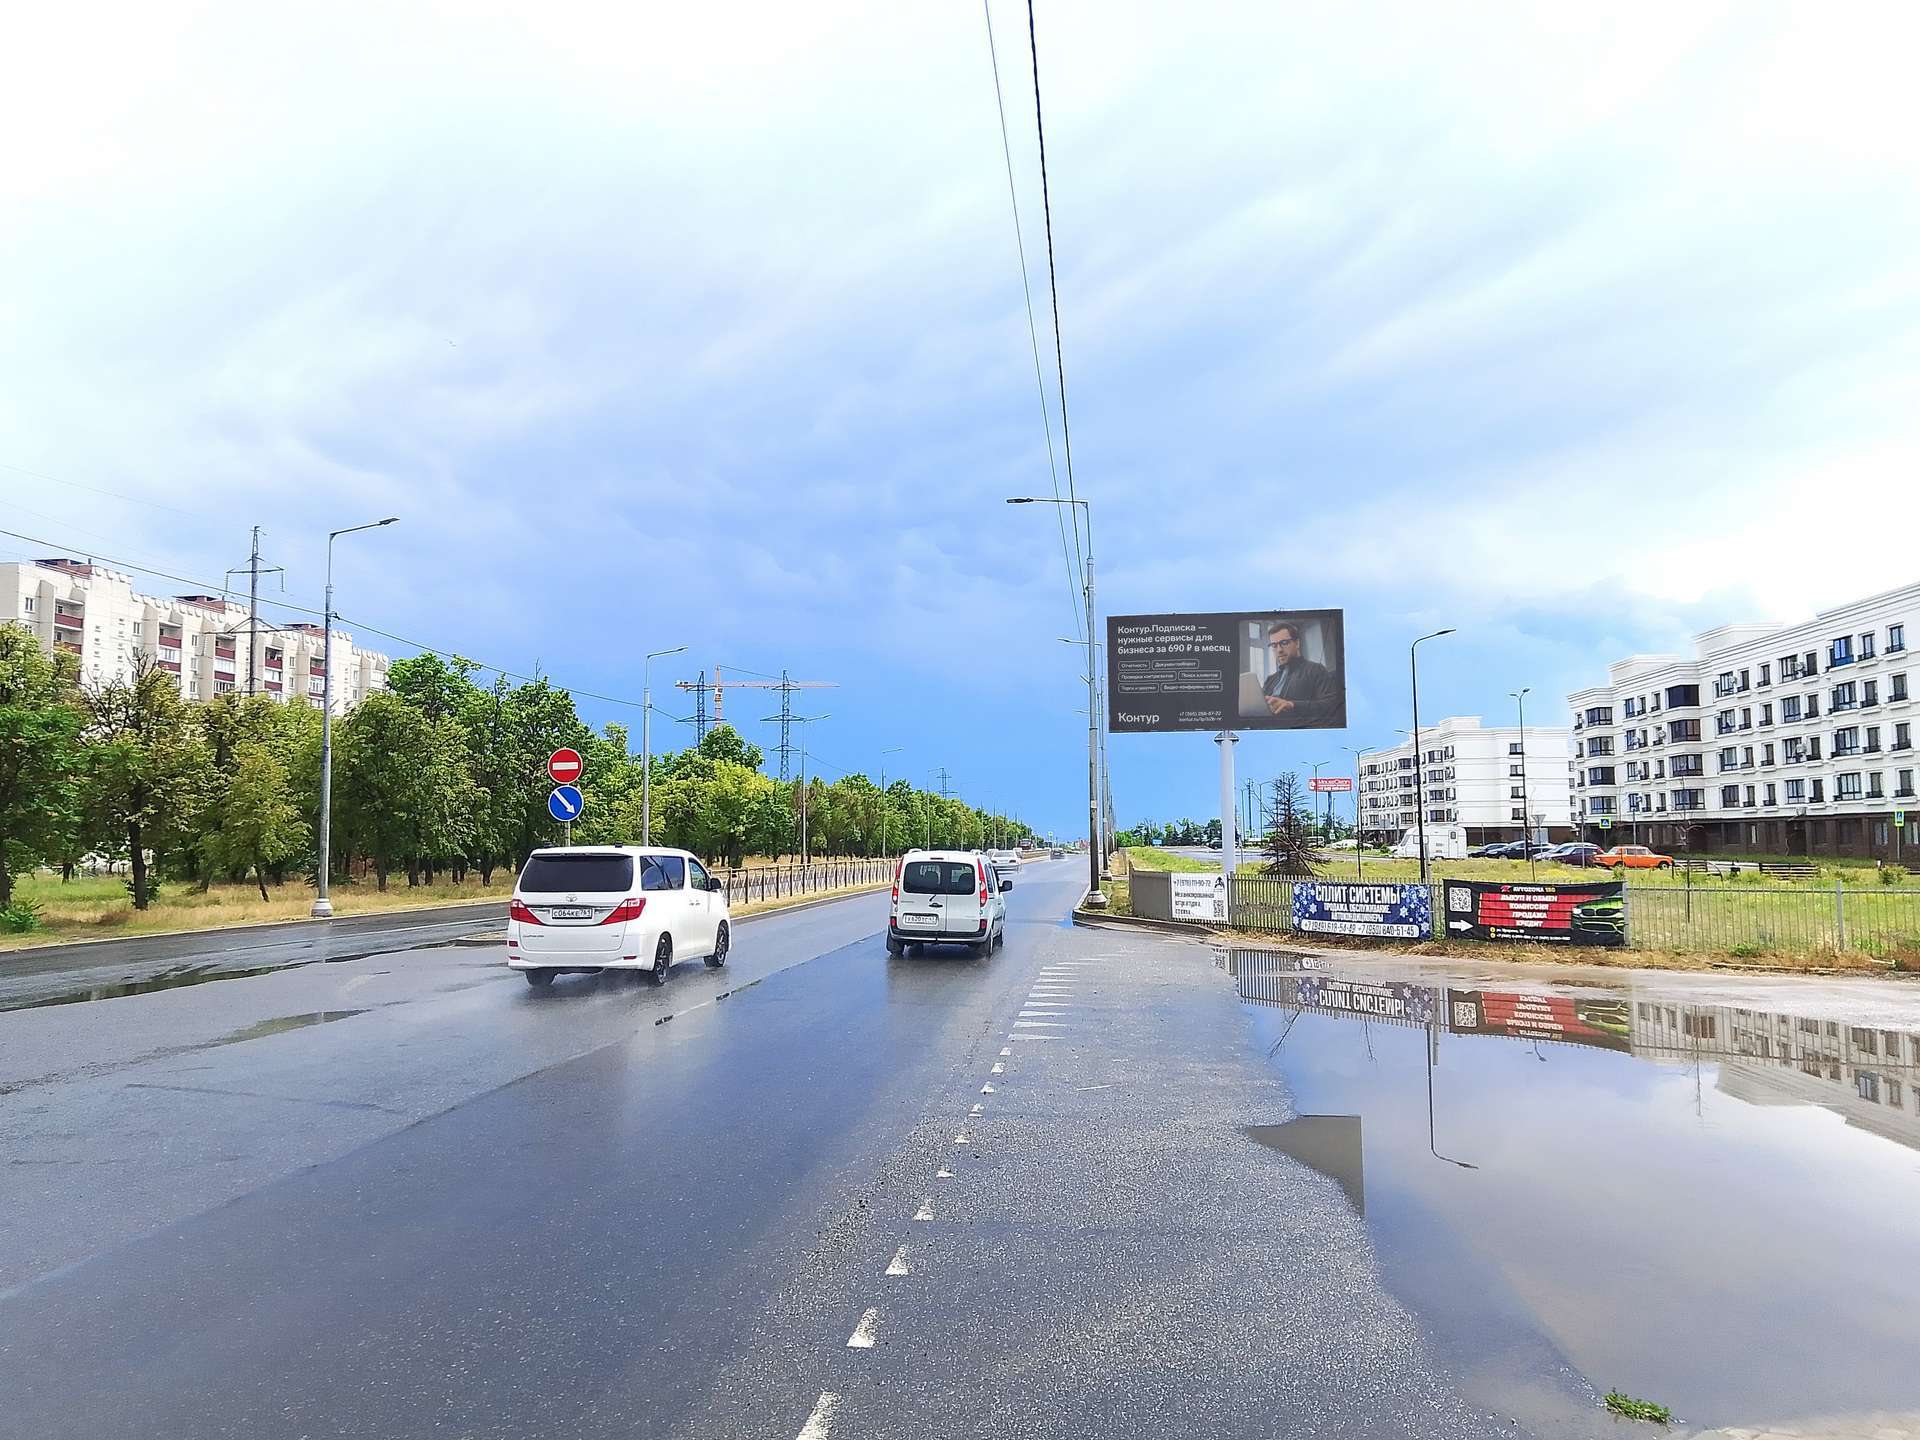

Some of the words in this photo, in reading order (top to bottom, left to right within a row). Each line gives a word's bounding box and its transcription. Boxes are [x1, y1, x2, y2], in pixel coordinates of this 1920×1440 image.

[1118, 624, 1196, 635] Контур.Подписка
[1118, 637, 1152, 645] нужные
[1154, 635, 1194, 644] сервисы
[1118, 646, 1154, 654] бизнеса
[1168, 644, 1184, 652] 690
[1118, 712, 1160, 724] Контур
[1315, 886, 1347, 901] СПЛИТ
[1350, 886, 1400, 904] СИСТЕМЫ
[1304, 921, 1311, 930] +7
[1358, 924, 1365, 934] +7
